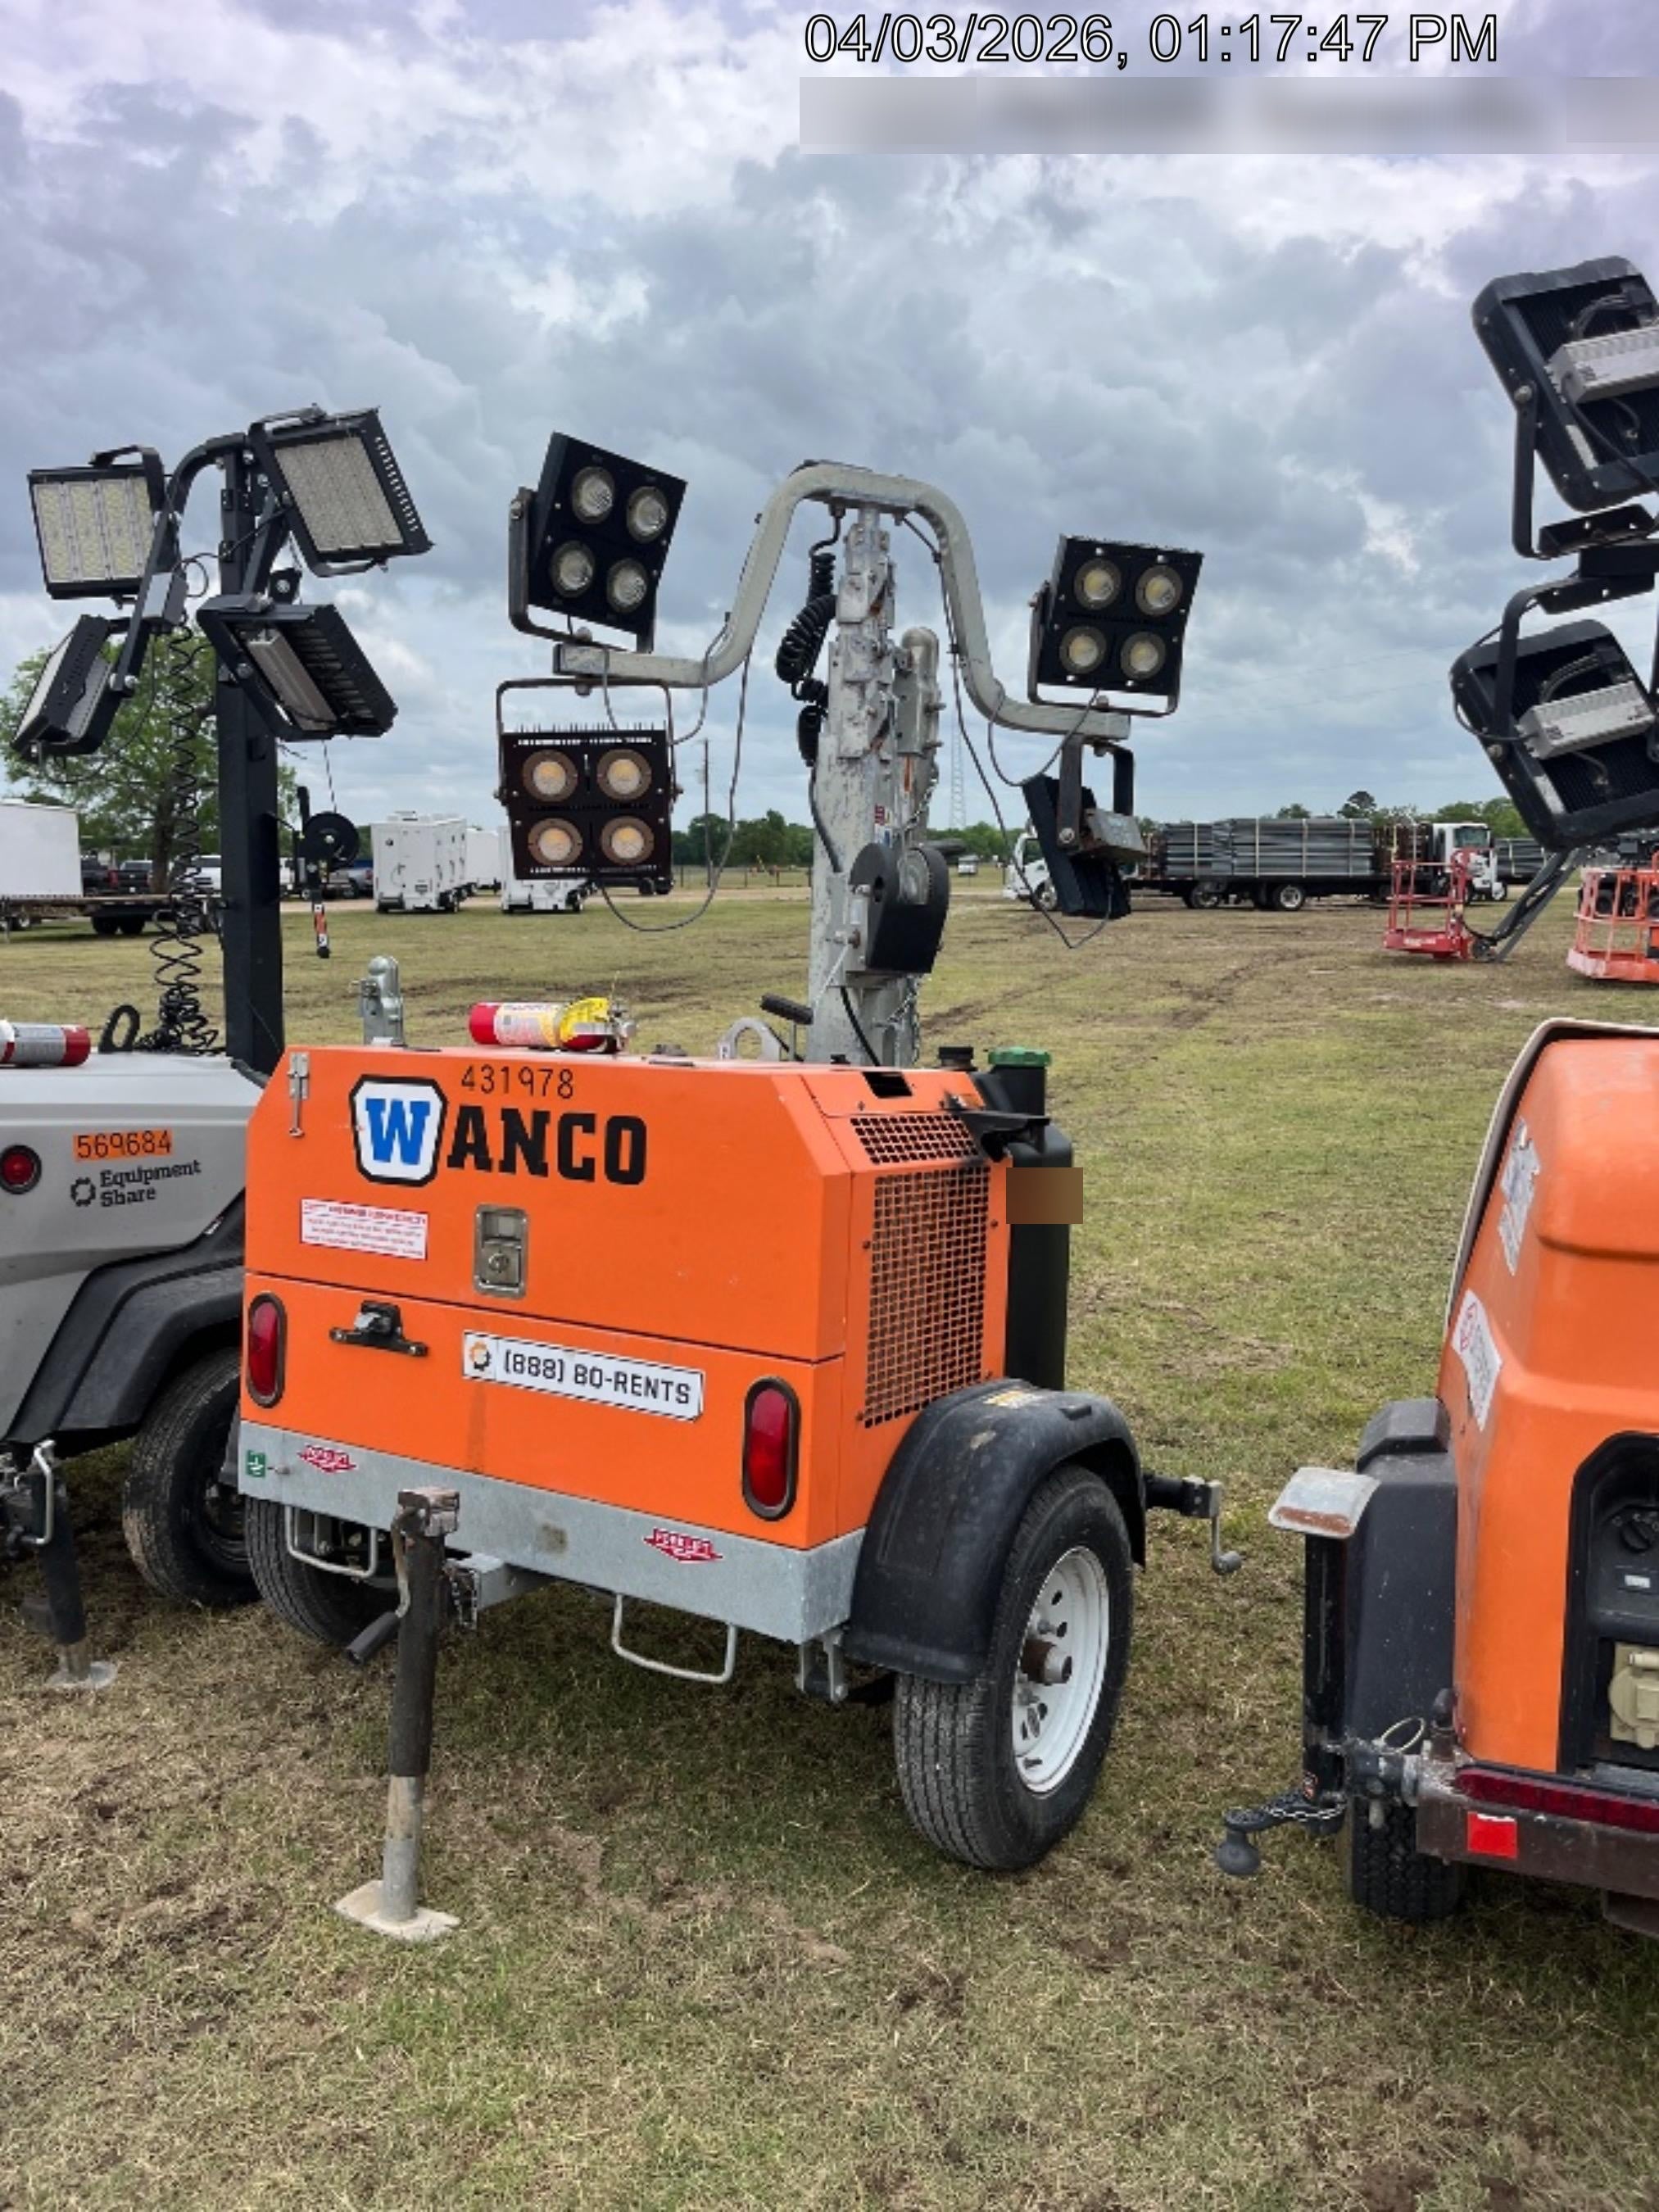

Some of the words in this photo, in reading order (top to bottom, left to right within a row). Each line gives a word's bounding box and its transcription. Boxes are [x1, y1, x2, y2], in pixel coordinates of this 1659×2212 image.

[460, 1063, 574, 1099] 431978
[77, 1130, 171, 1158] 569684
[365, 1096, 647, 1185] WANCO
[99, 1159, 202, 1188] Equipment
[100, 1186, 156, 1208] Share
